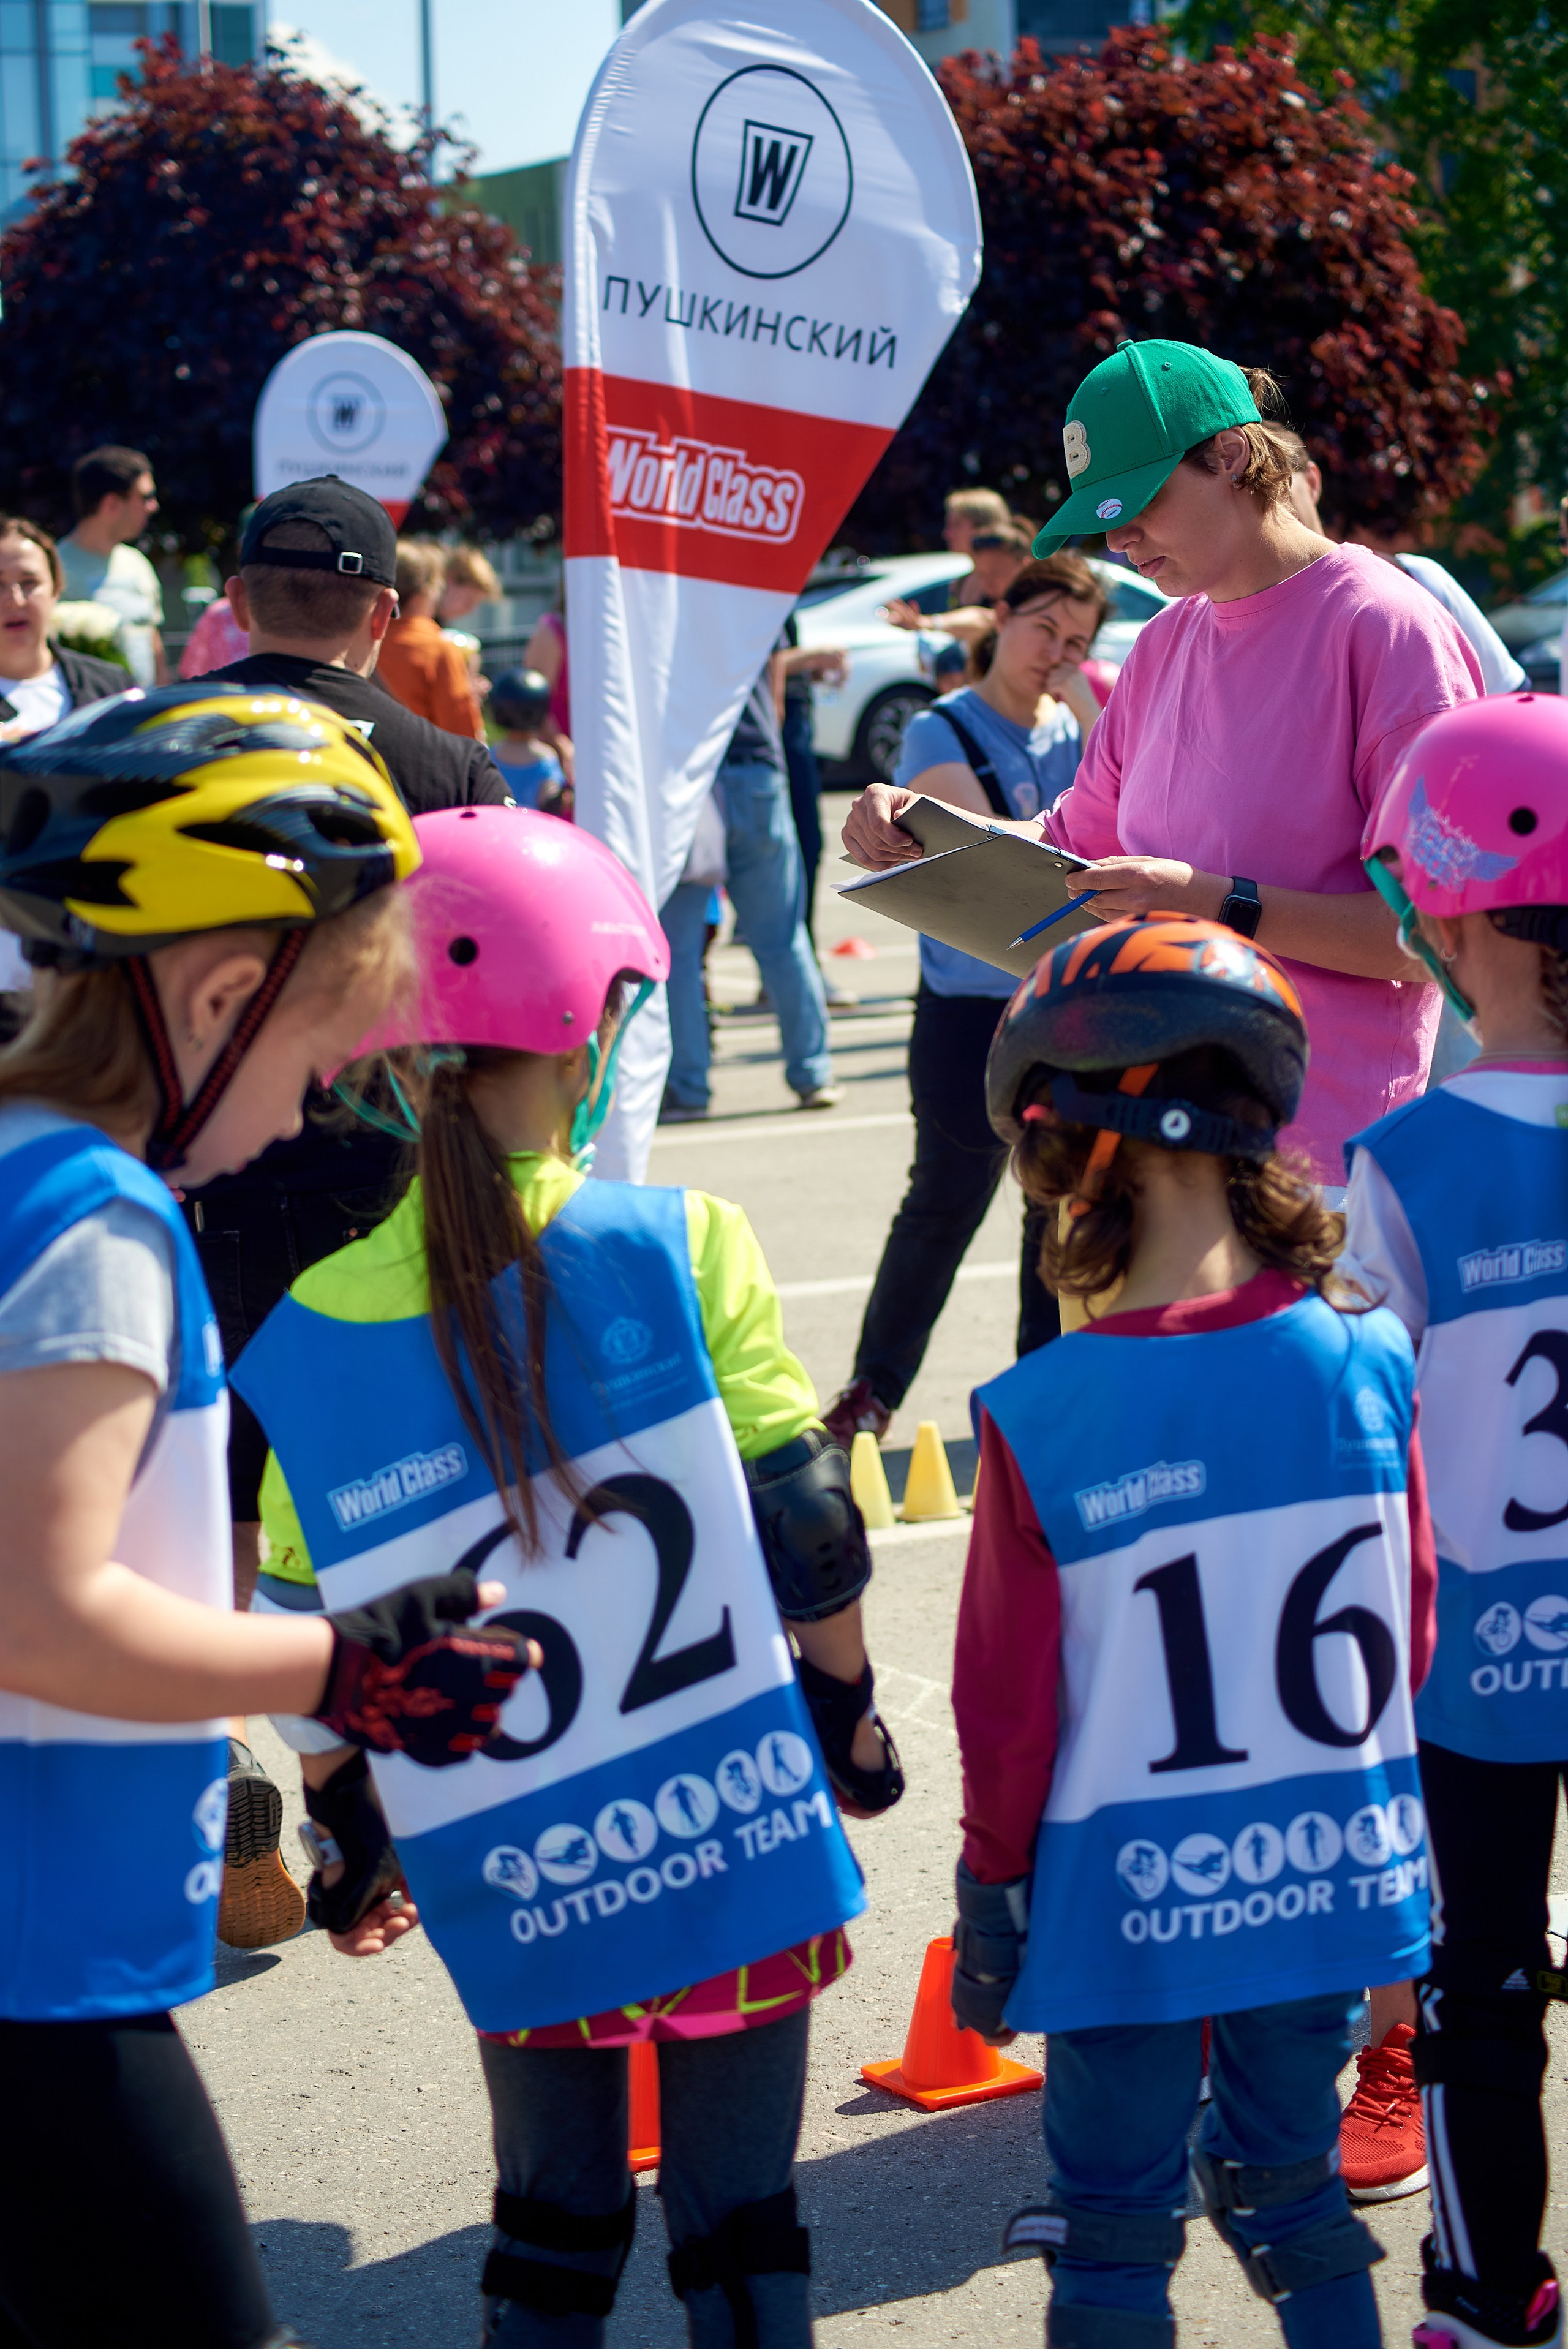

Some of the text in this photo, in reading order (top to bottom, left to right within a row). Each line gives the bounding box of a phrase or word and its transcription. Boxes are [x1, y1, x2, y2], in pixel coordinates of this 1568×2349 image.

[748, 135, 799, 211] W
[603, 274, 897, 369] ПУШКИНСКИЙ
[608, 437, 797, 533] World Class
[1063, 420, 1091, 480] B
[1461, 1246, 1520, 1287] World
[335, 1447, 464, 1525] World Class
[1082, 1474, 1147, 1525] World
[1133, 1521, 1397, 1774] 16
[510, 1790, 833, 1944] OUTDOOR TEAM
[1121, 1879, 1335, 1944] OUTDOOR
